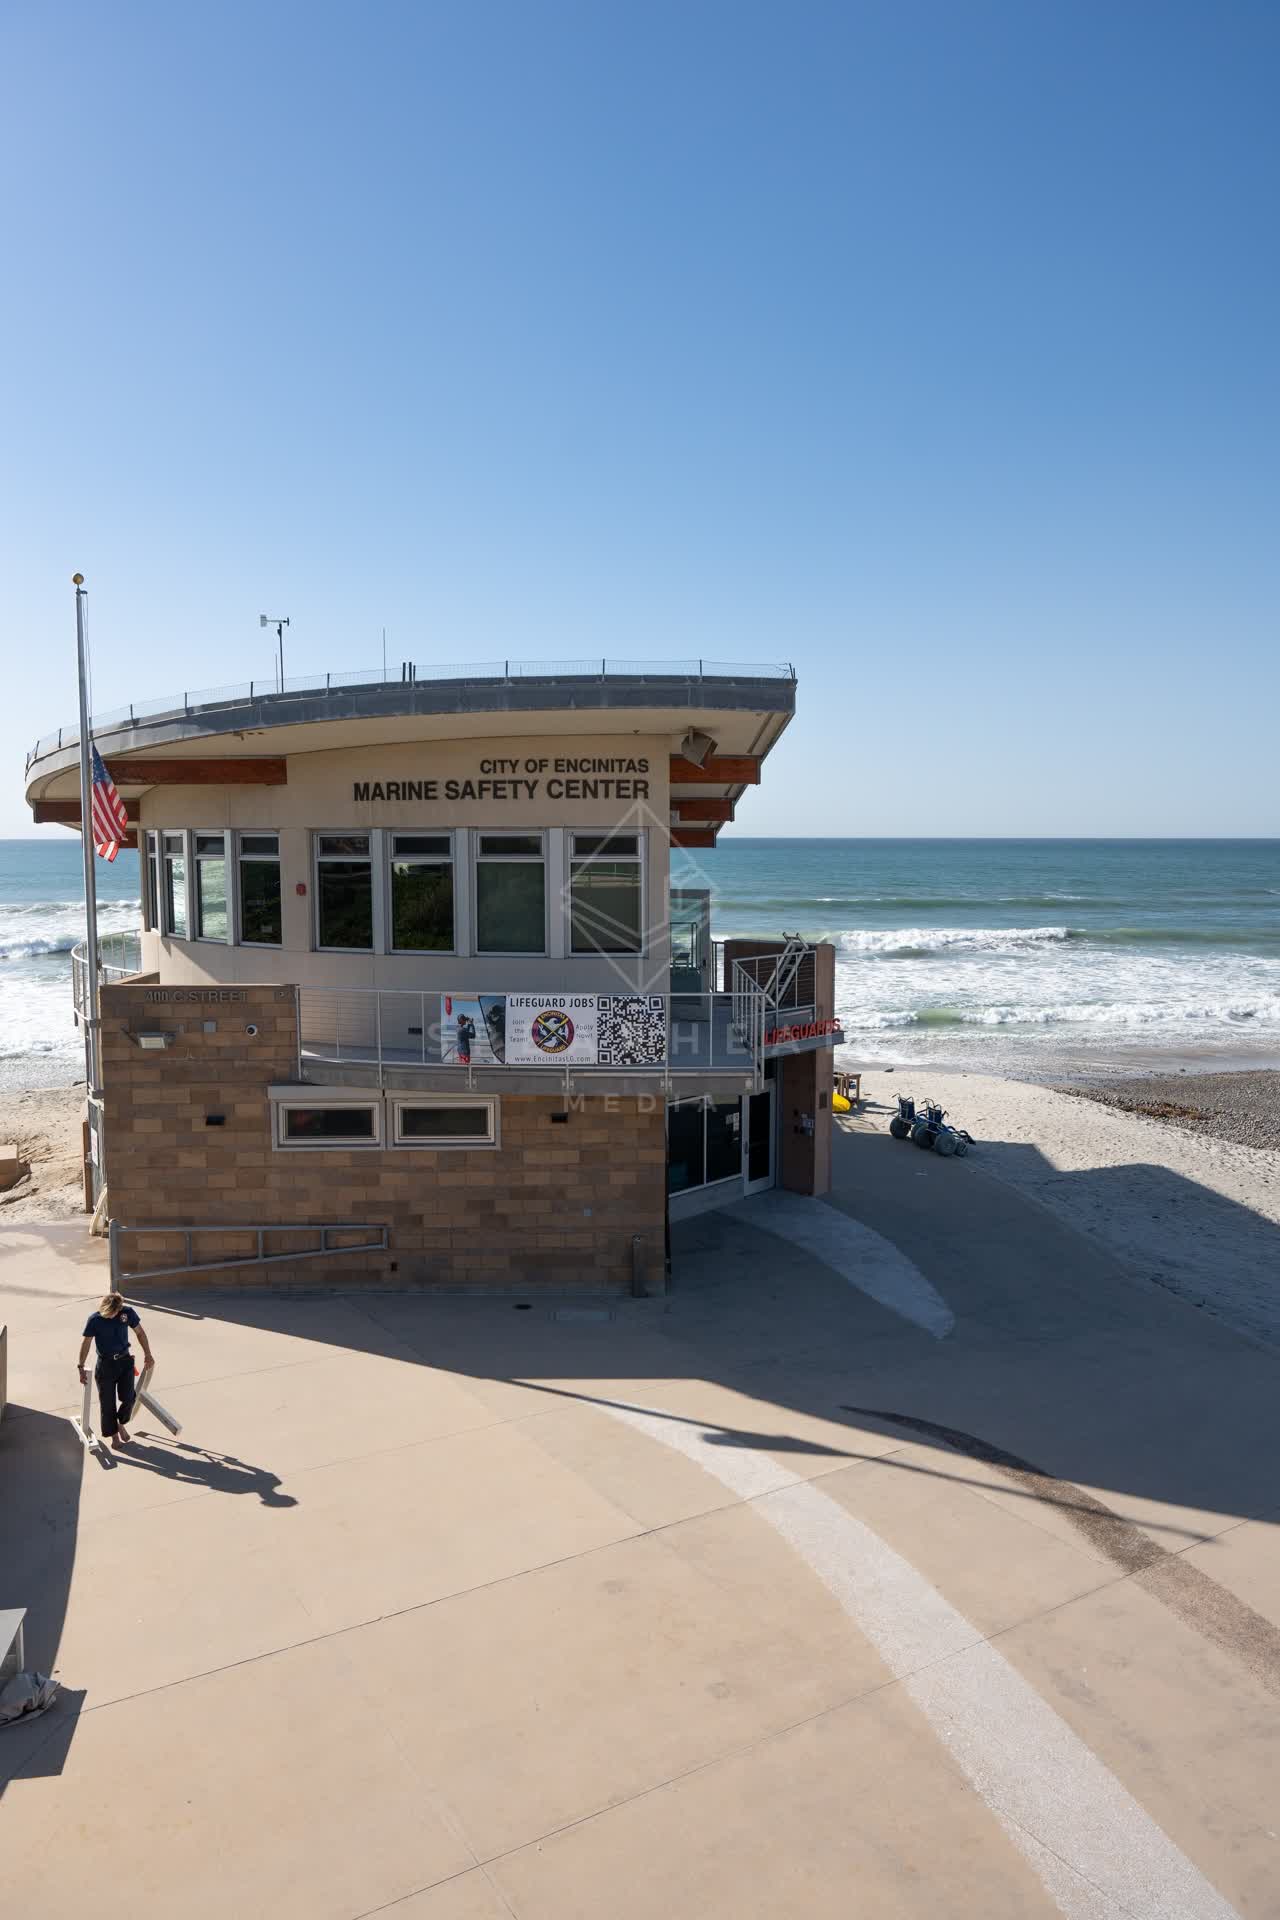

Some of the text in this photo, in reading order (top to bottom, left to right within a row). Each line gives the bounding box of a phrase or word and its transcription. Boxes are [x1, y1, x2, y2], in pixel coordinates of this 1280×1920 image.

[480, 758, 649, 774] CITY OF ENCINITAS
[354, 779, 649, 801] MARINE SAFETY CENTER
[188, 991, 248, 1001] STREET
[510, 998, 594, 1008] LIFEGUARD JOBS
[541, 1011, 565, 1019] ENCINITAS
[575, 1024, 594, 1032] Apply
[764, 1018, 840, 1046] LIFEGUARDS
